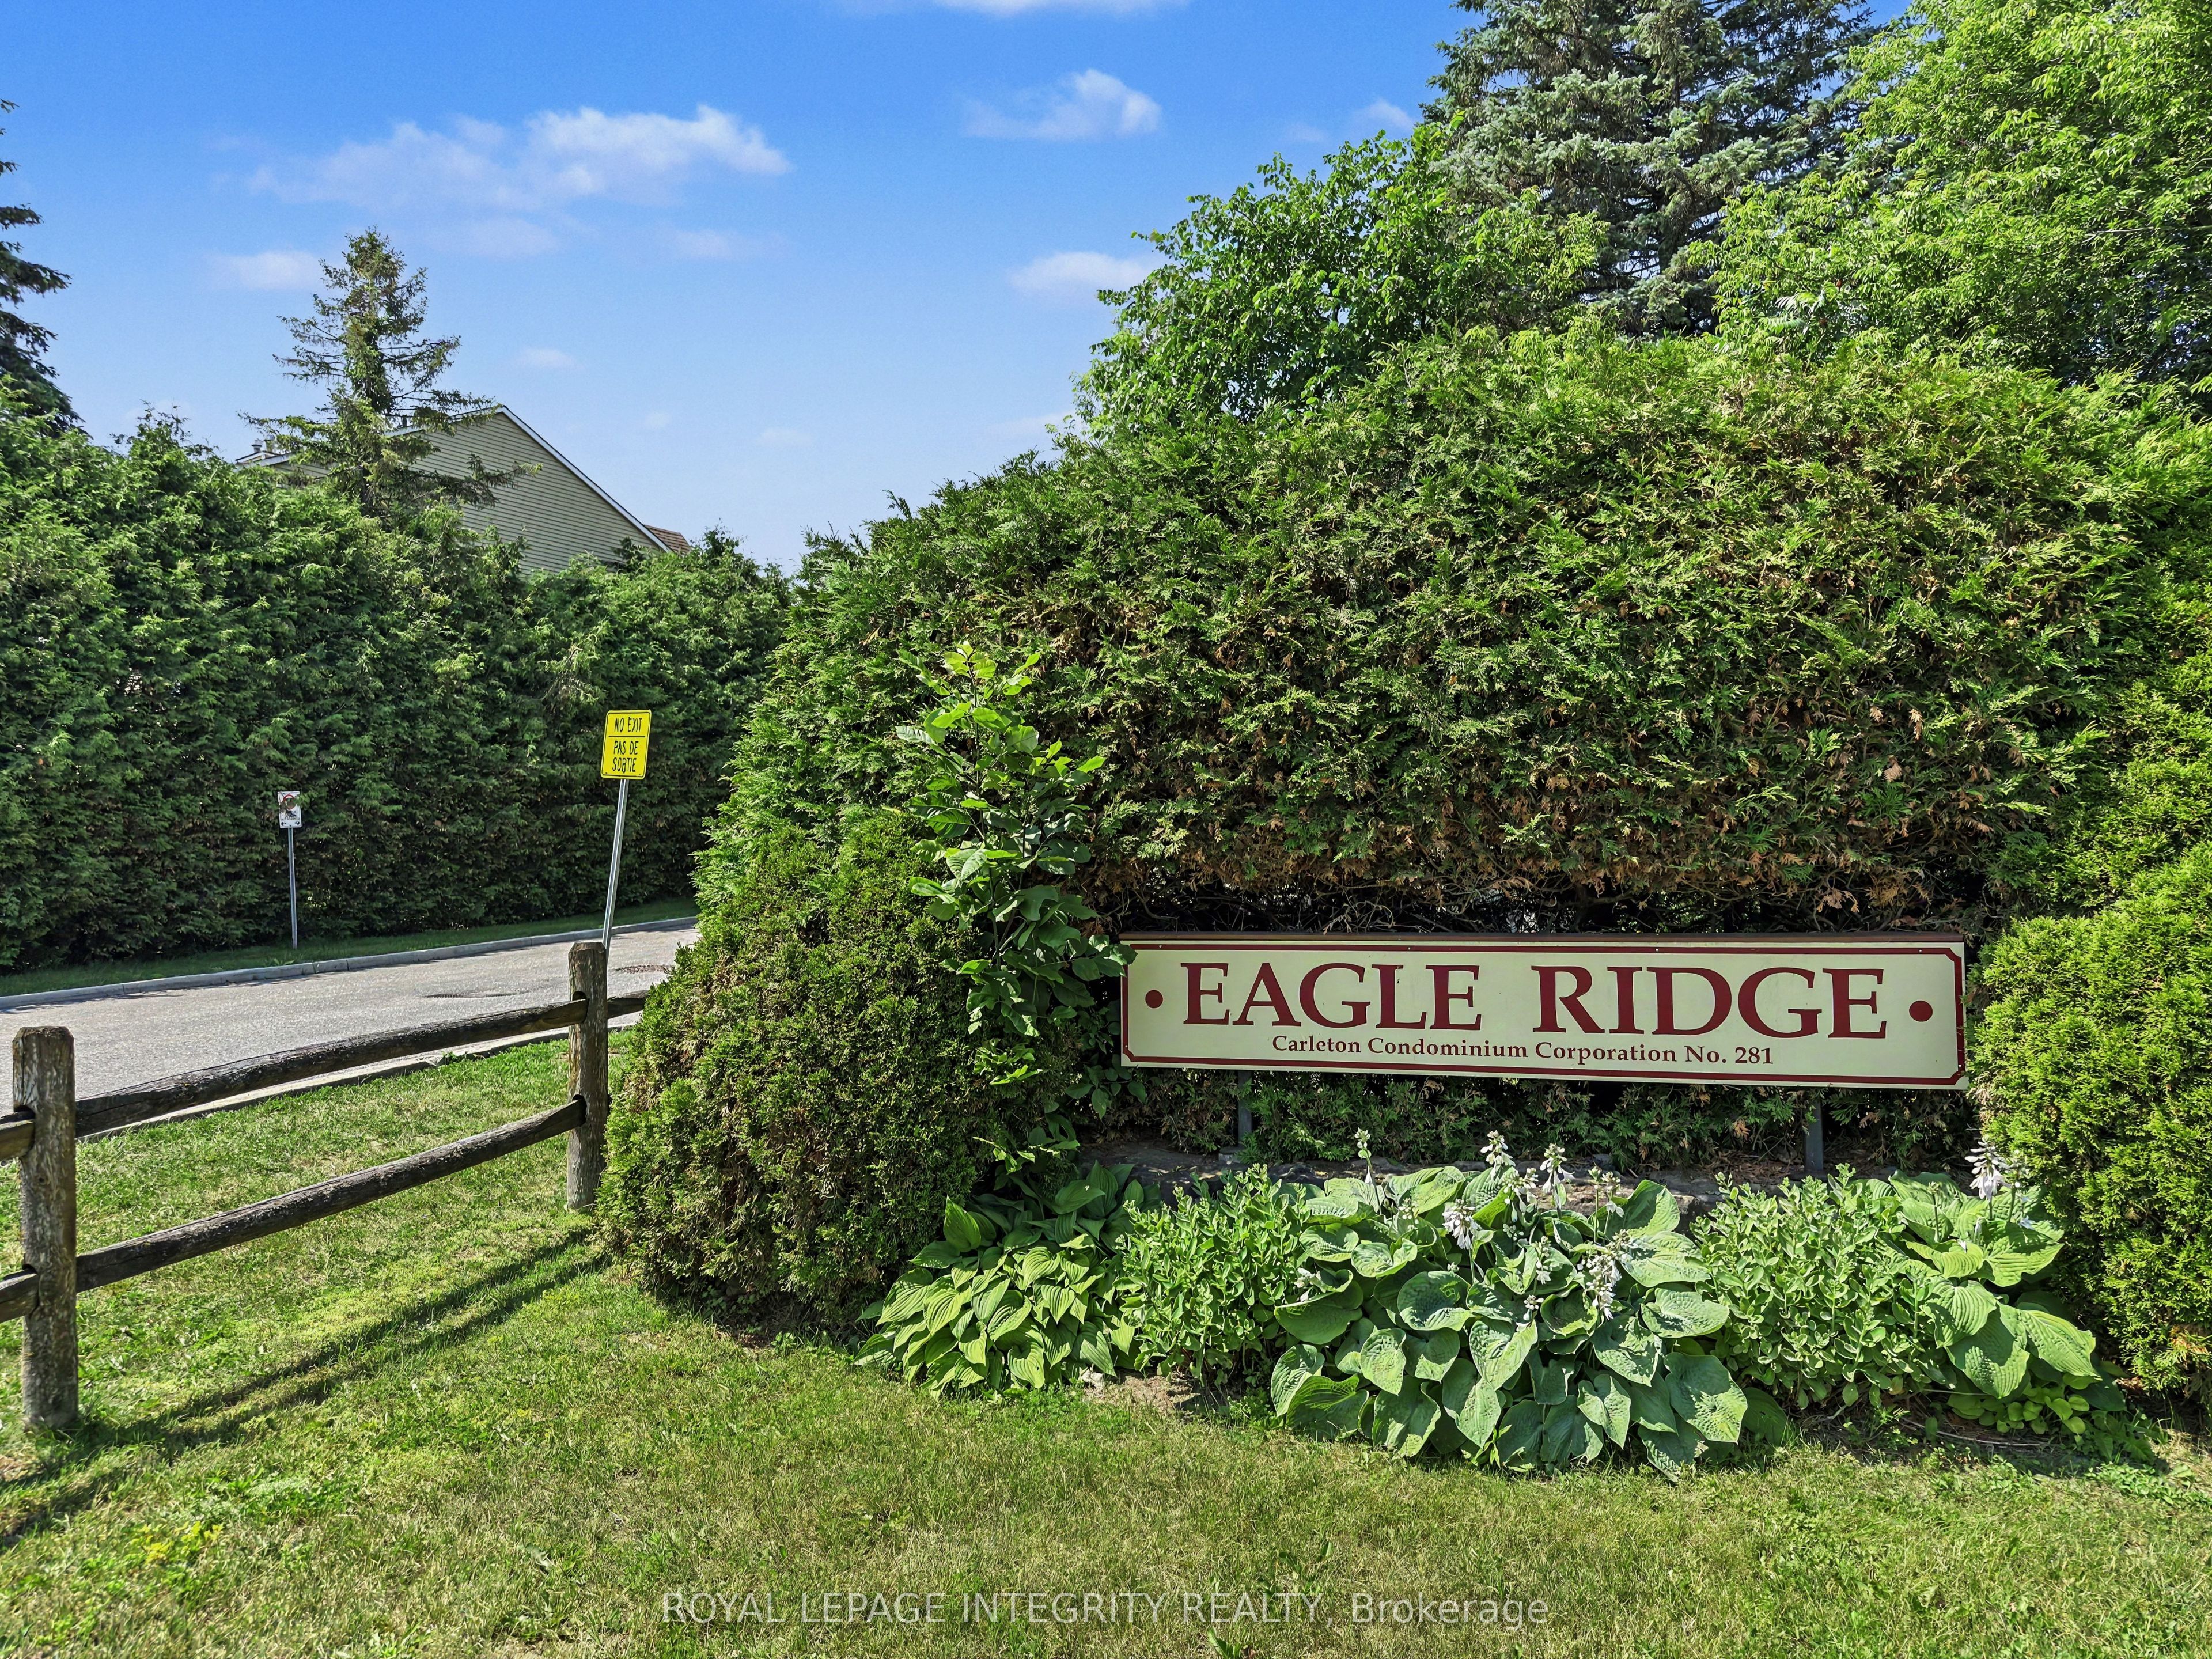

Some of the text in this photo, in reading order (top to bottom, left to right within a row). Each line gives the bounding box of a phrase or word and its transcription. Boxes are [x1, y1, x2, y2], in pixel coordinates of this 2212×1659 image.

[614, 717, 642, 732] NO EXIT
[613, 740, 639, 755] PAS DE
[612, 757, 637, 774] SORTIE
[1180, 963, 1887, 1039] EAGLE RIDGE
[1272, 1035, 1774, 1065] Carleton Condominium Corporation No. 281
